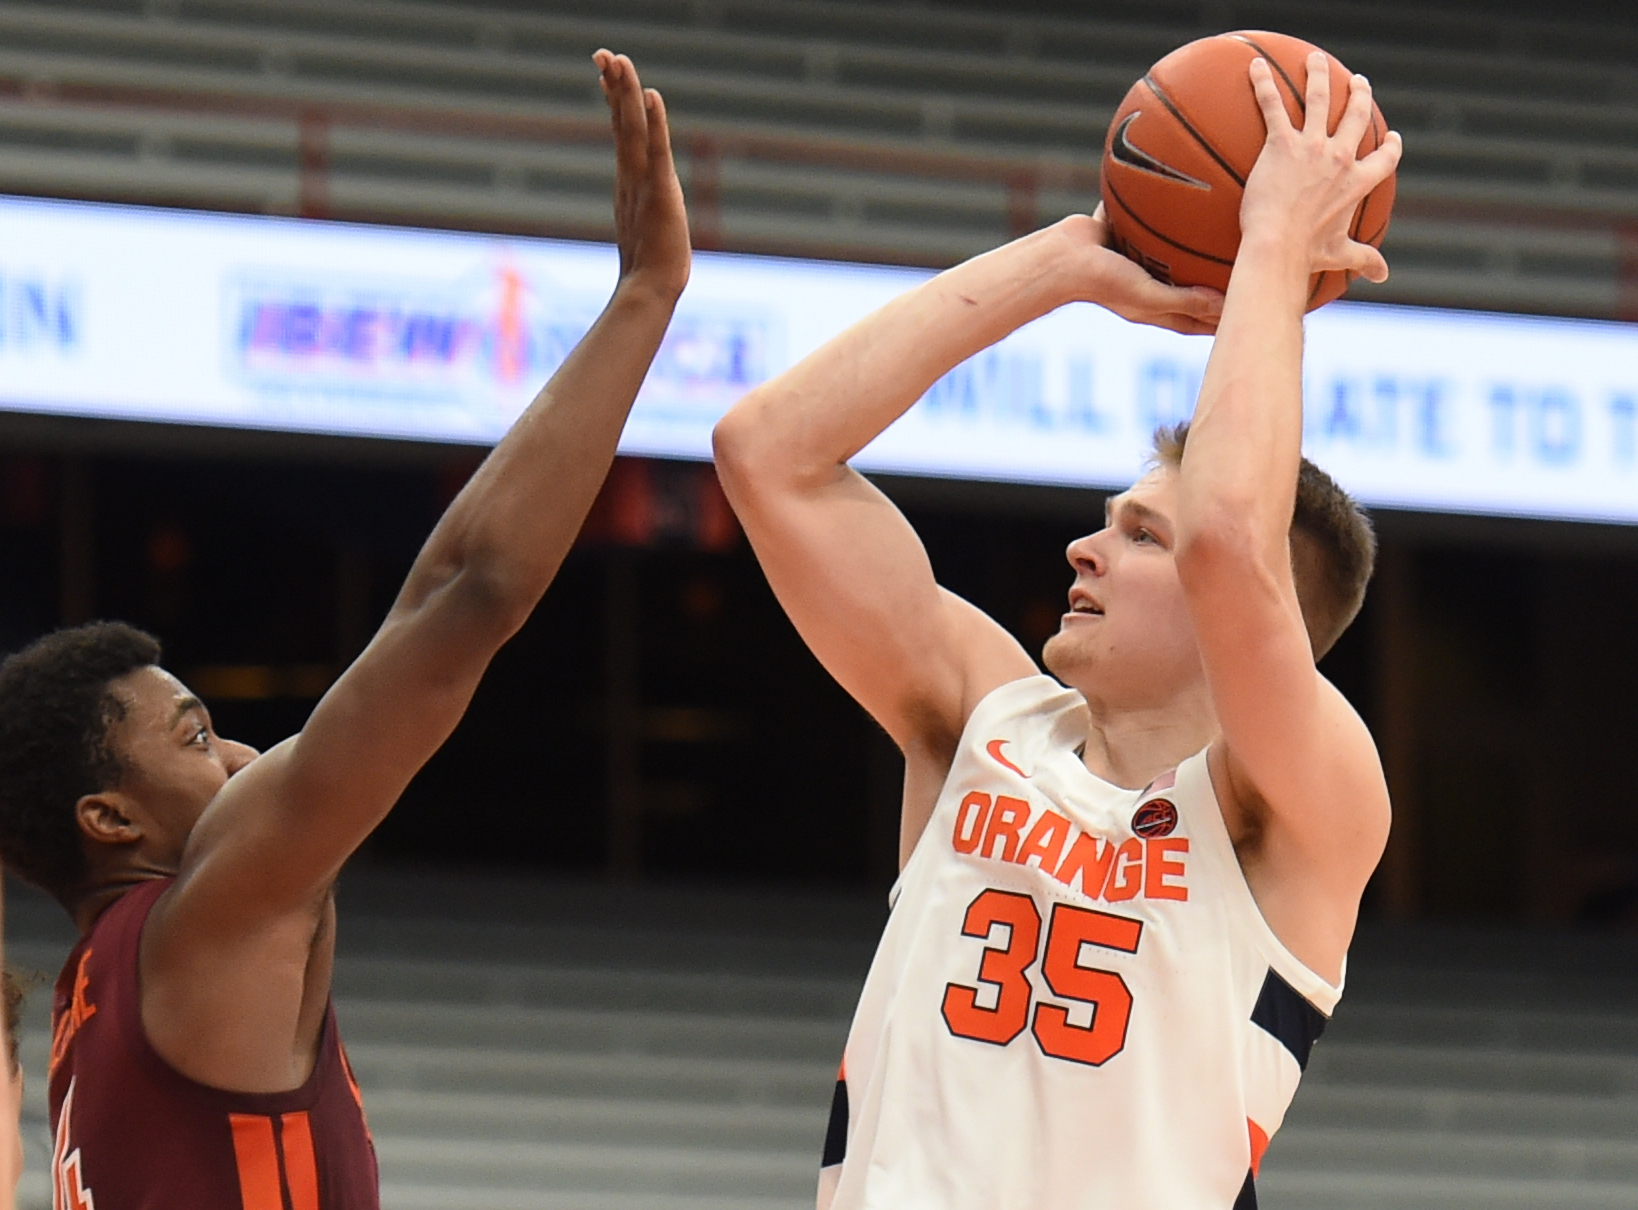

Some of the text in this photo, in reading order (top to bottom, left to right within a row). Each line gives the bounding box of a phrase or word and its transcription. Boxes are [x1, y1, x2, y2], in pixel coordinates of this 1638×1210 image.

[1487, 384, 1581, 468] TO
[952, 790, 1189, 903] ORANGE
[941, 887, 1143, 1067] 35
